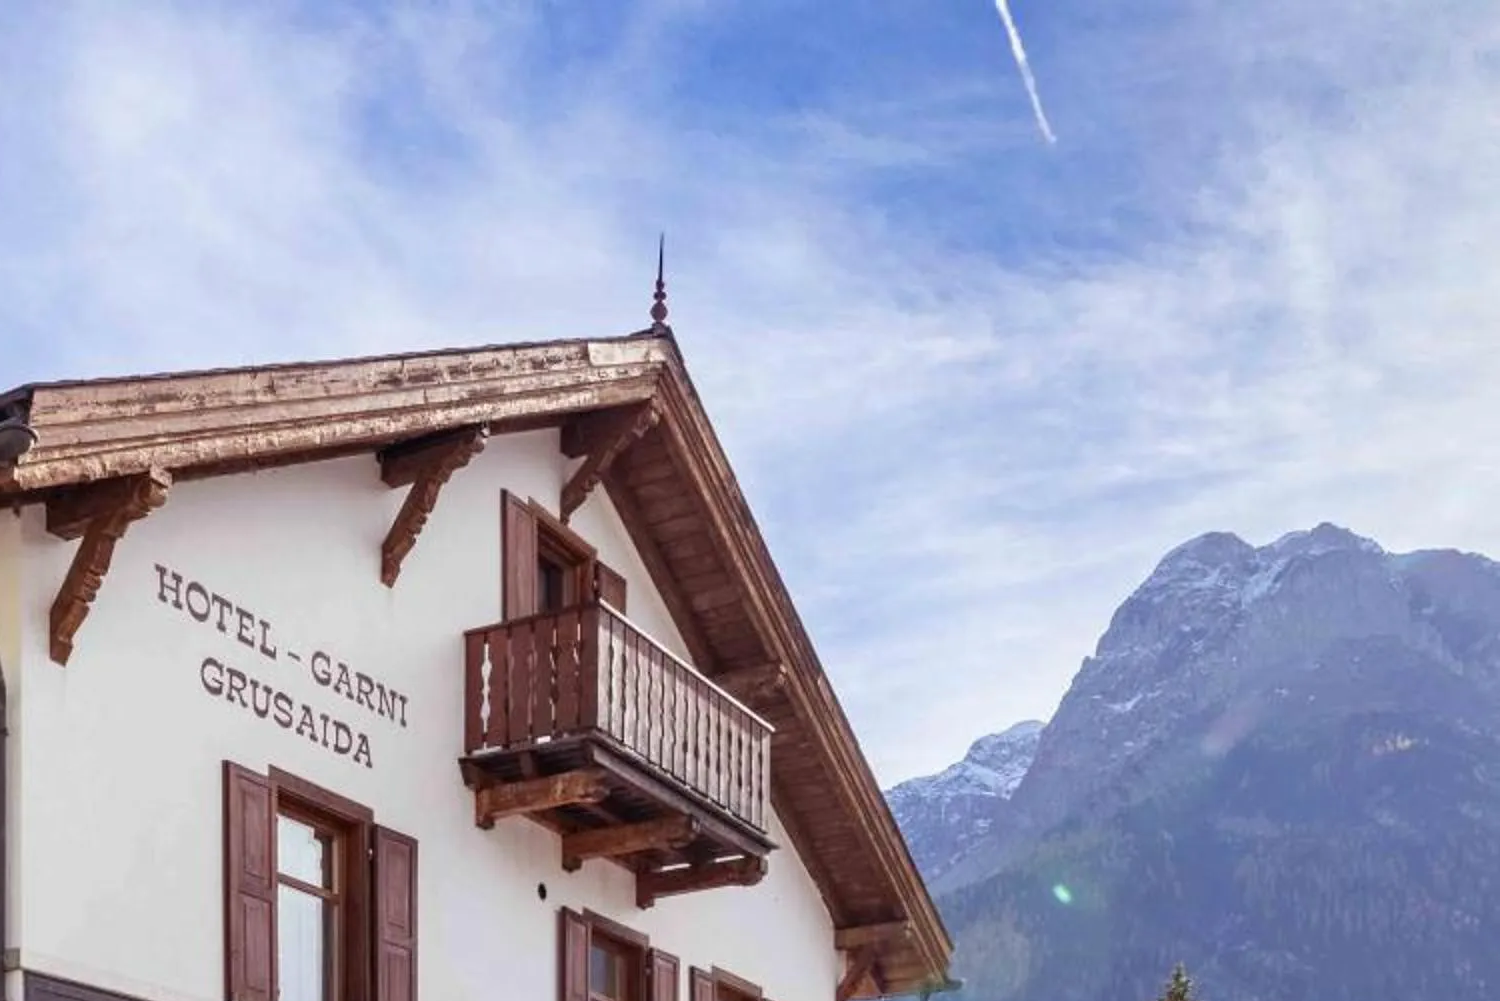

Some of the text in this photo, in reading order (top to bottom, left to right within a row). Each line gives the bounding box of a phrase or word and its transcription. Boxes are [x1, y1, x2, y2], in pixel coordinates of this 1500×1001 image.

[154, 563, 277, 660] HOTEL
[311, 651, 409, 728] GARNI
[200, 657, 373, 769] GRUSAIDA
